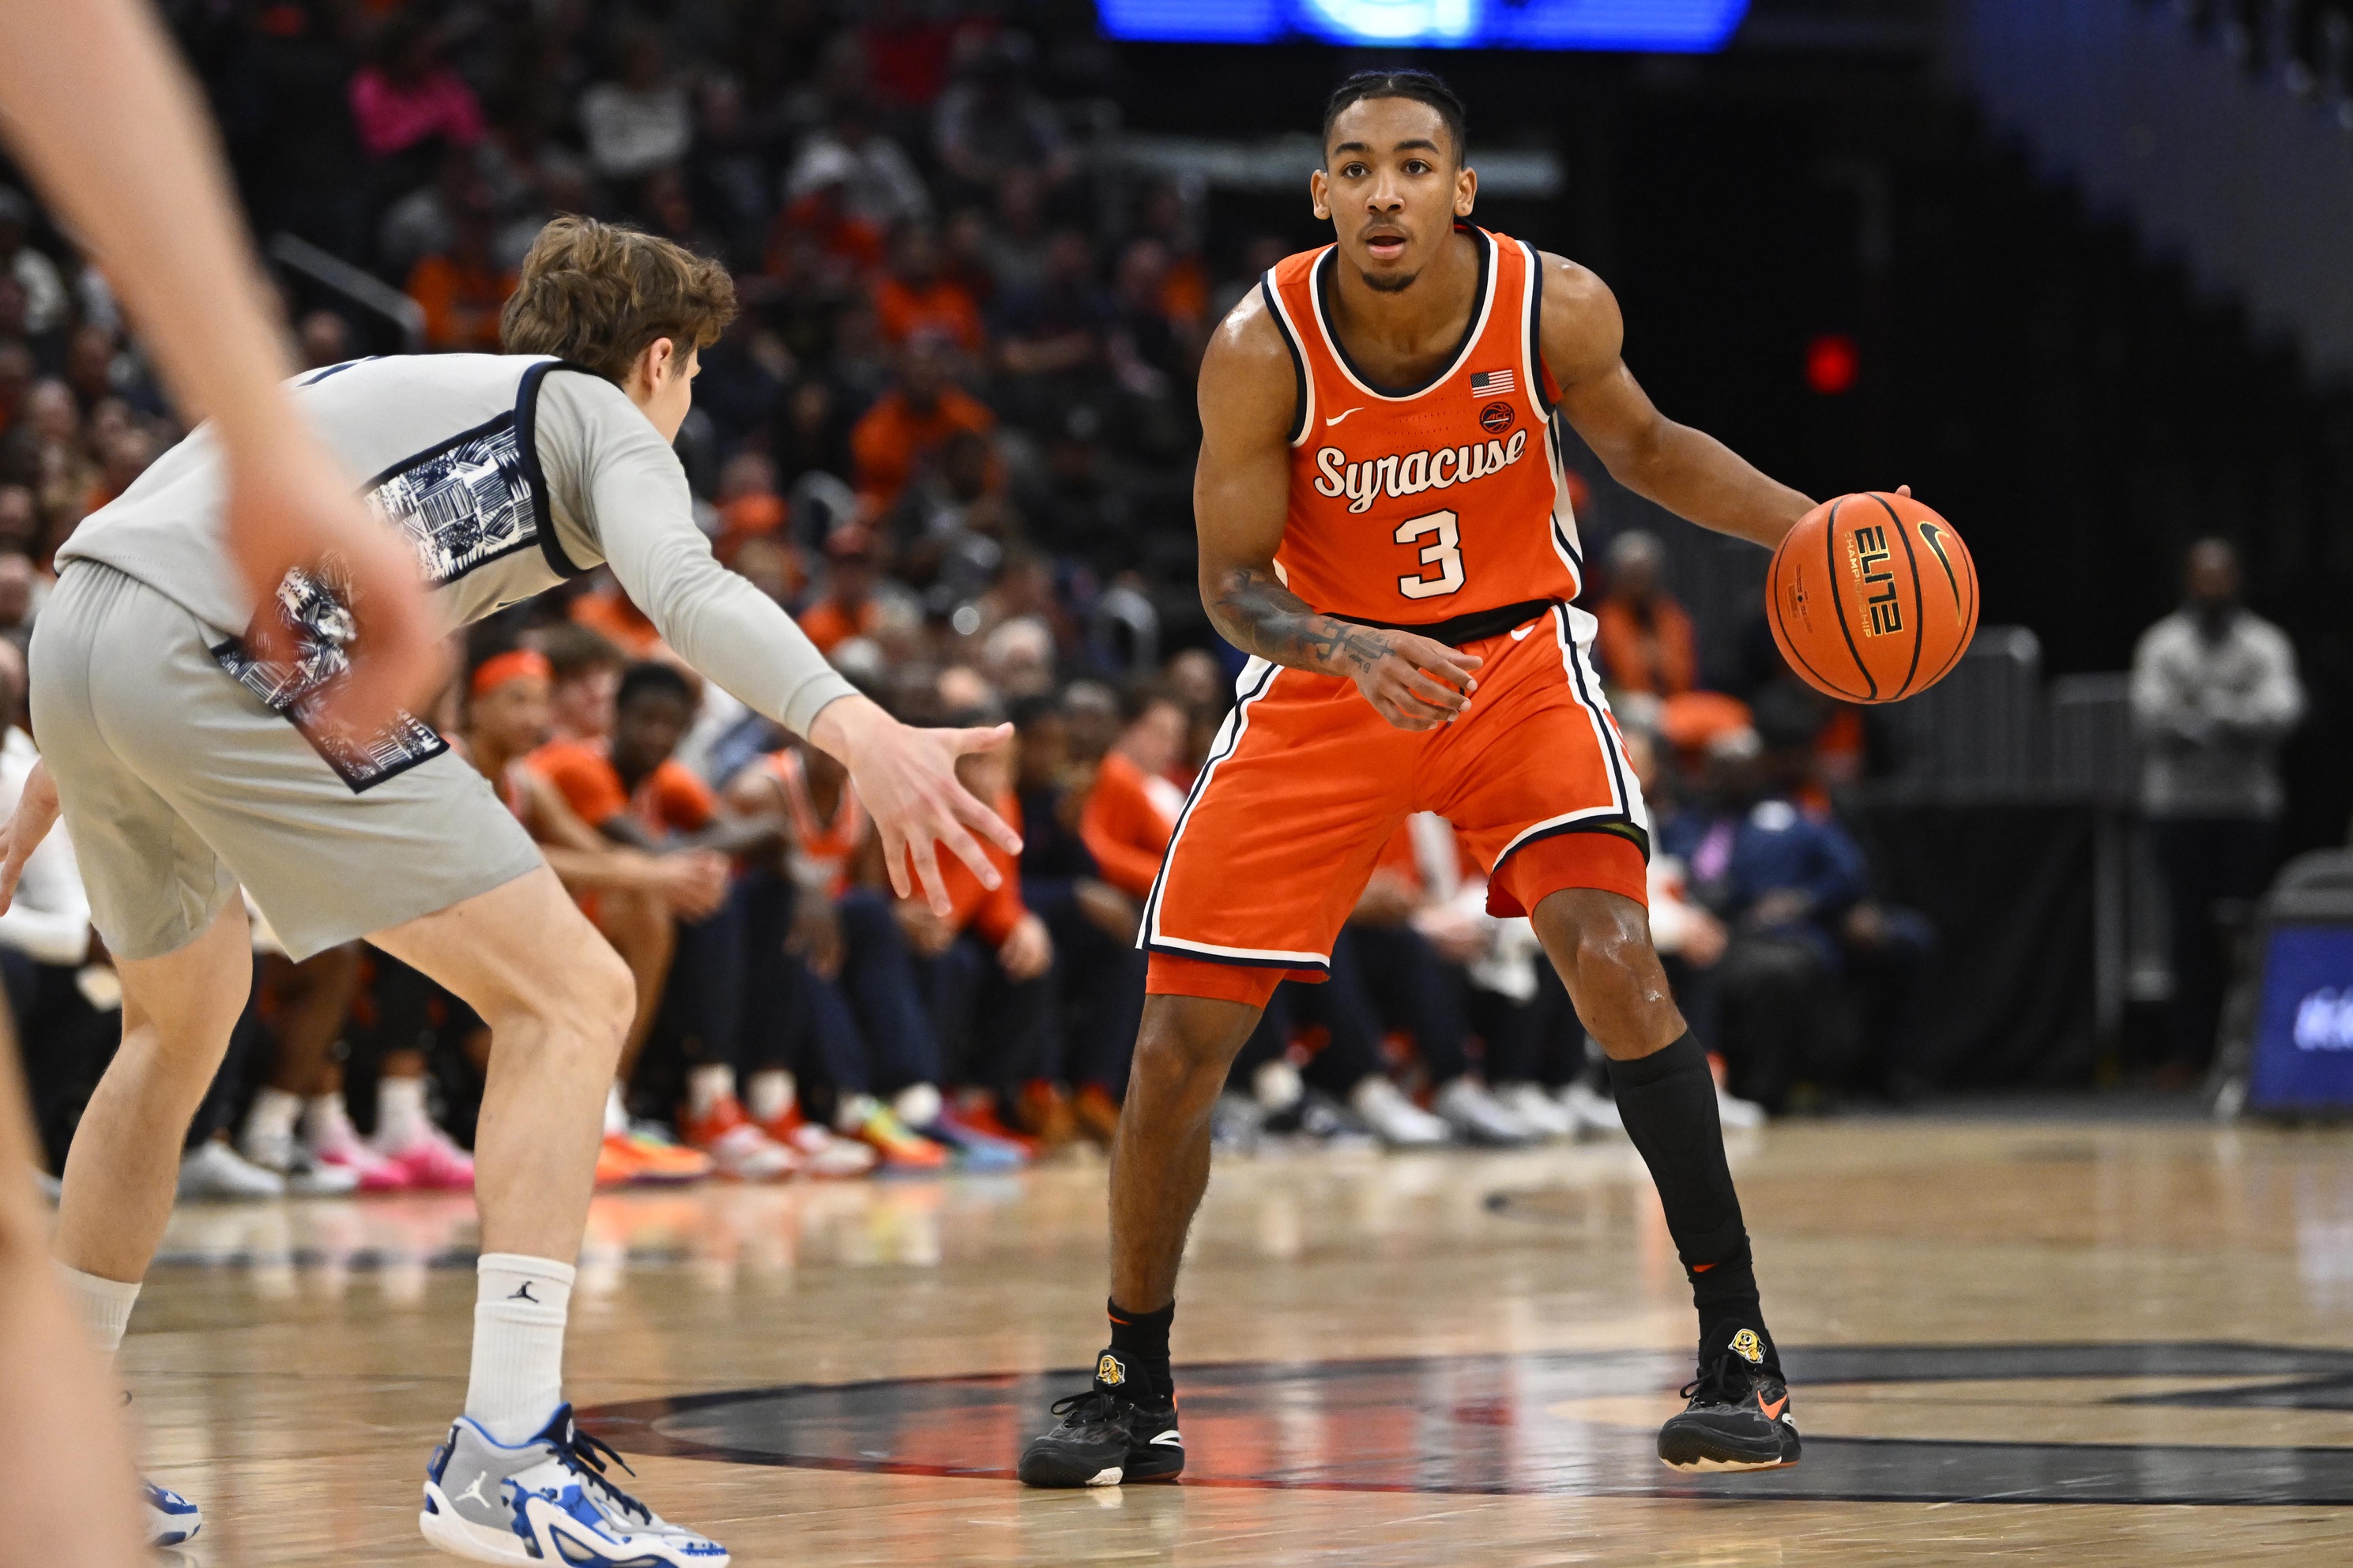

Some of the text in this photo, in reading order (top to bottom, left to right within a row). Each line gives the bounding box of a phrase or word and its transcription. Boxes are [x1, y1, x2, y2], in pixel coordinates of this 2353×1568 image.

[1485, 411, 1511, 420] ACC
[1313, 429, 1527, 514] Syracuse
[1393, 508, 1466, 600] 3
[1854, 525, 1903, 637] ELITE
